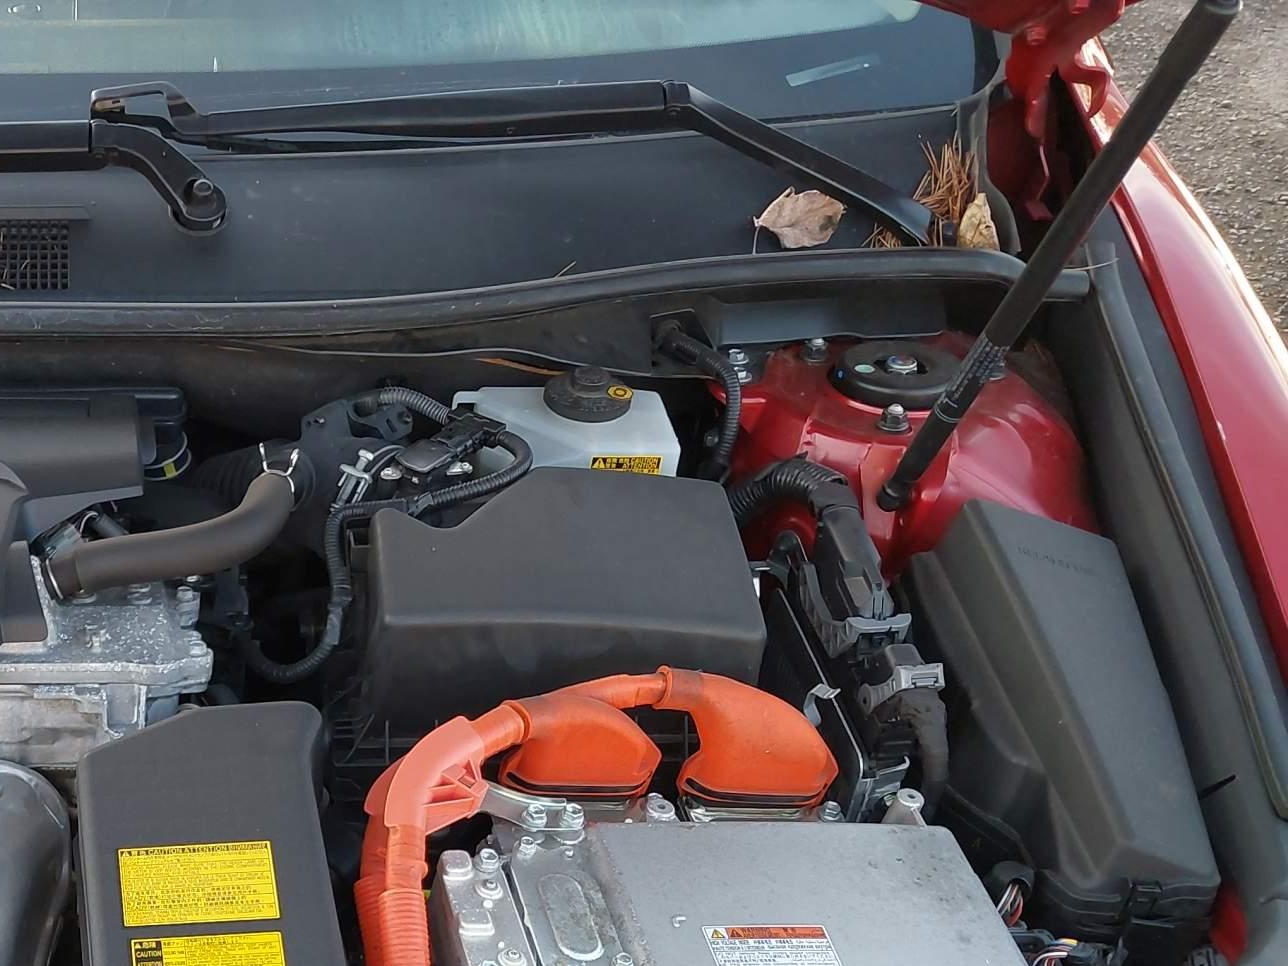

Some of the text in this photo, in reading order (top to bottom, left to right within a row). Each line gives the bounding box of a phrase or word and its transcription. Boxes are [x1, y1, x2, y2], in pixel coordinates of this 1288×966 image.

[148, 848, 183, 856] CAUTION
[184, 845, 229, 854] ATTENTION
[136, 950, 162, 958] CAUTION
